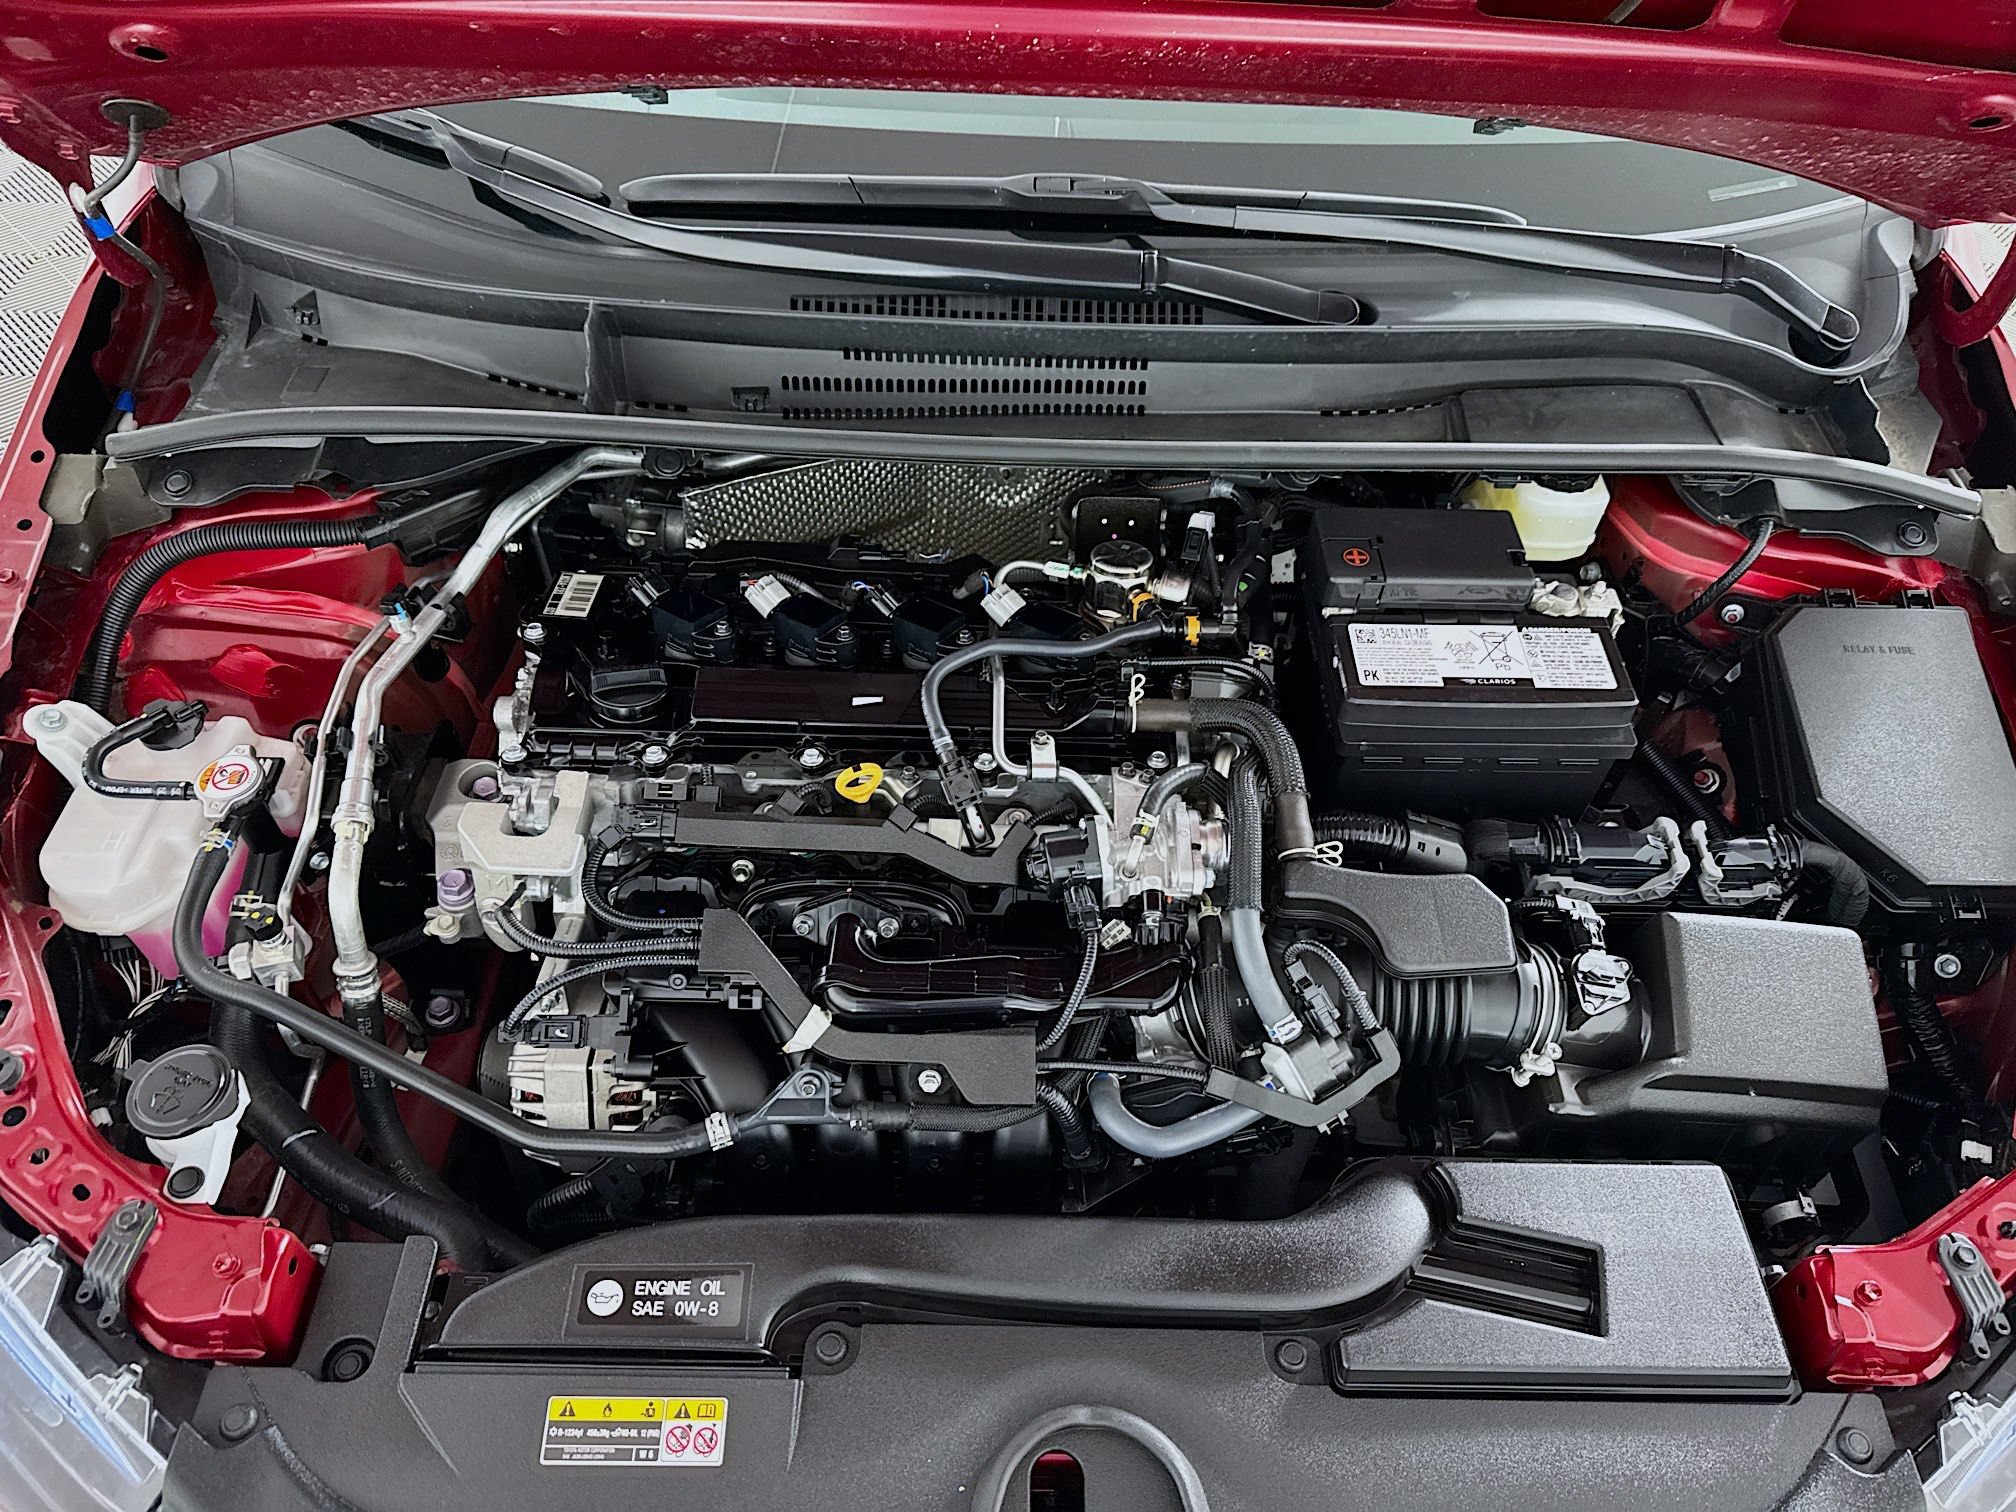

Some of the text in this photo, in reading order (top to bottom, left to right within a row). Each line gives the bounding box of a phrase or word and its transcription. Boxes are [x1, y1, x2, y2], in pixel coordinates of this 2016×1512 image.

[1380, 627, 1429, 639] 345LN1-MF
[1843, 644, 1875, 654] RELAY
[1888, 645, 1916, 655] FUSE
[1495, 663, 1511, 671] Pb
[1363, 669, 1380, 681] PK
[635, 1280, 725, 1296] ENGINE OIL
[631, 1300, 719, 1317] SAE 0W-8
